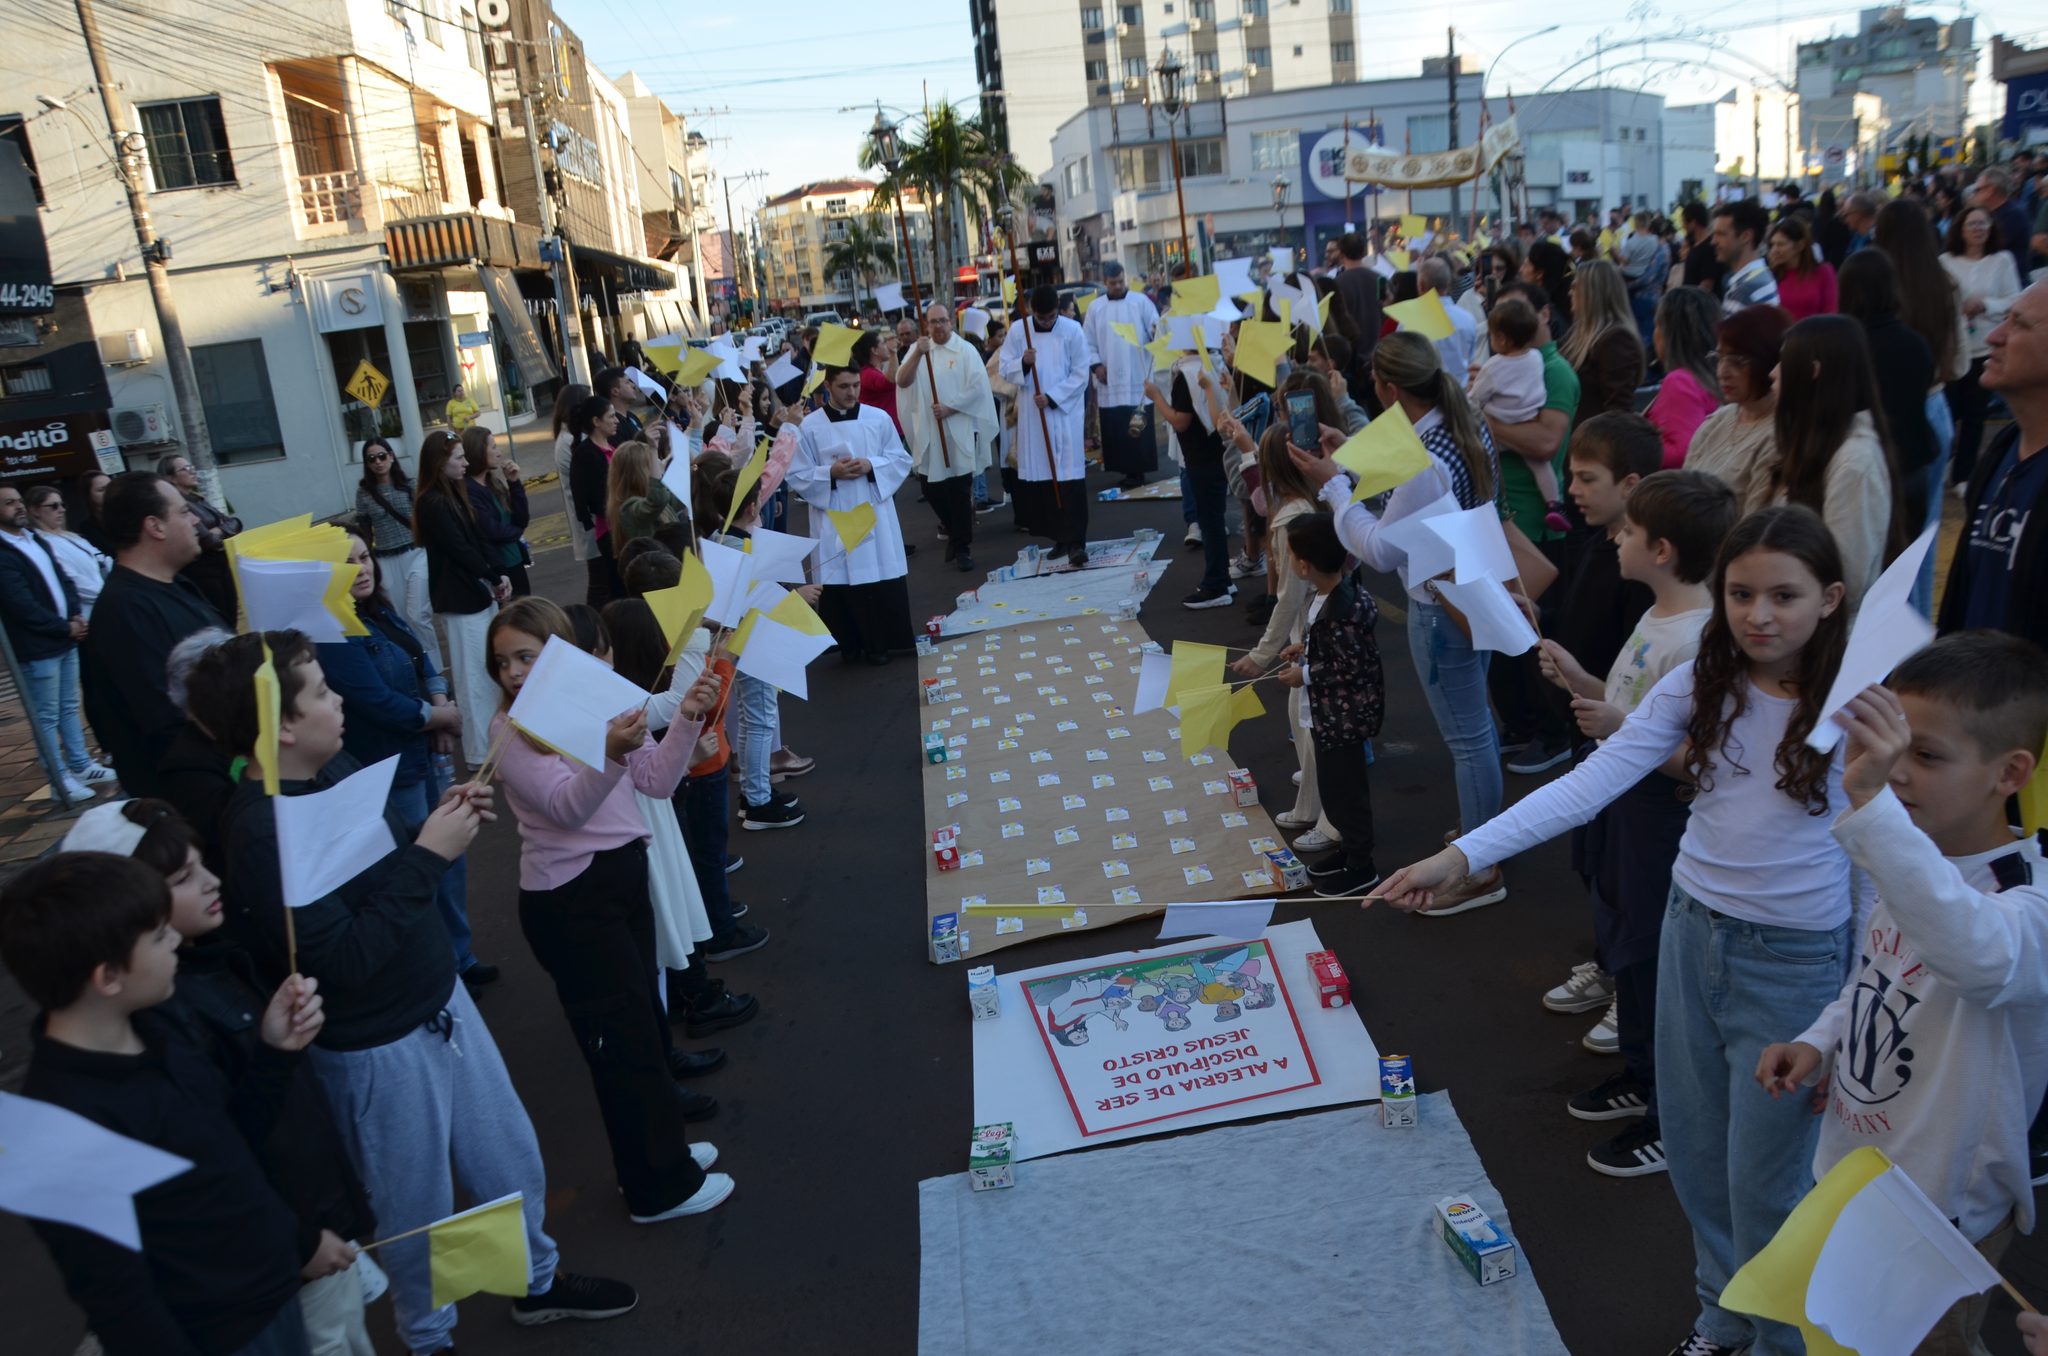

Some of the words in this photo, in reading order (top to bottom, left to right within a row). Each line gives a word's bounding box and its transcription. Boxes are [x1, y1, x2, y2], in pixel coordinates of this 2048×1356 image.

[0, 283, 54, 307] 44-2945
[1183, 1028, 1250, 1053] JESUS
[1102, 1045, 1179, 1071] CRISTO
[1146, 1044, 1259, 1080] DISCÍPULO
[1273, 1057, 1288, 1069] A
[1111, 1072, 1142, 1089] DE
[1178, 1061, 1268, 1092] ALEGRIA
[1095, 1092, 1140, 1111] SER
[1144, 1084, 1175, 1101] DE
[1448, 1207, 1476, 1217] Aurora
